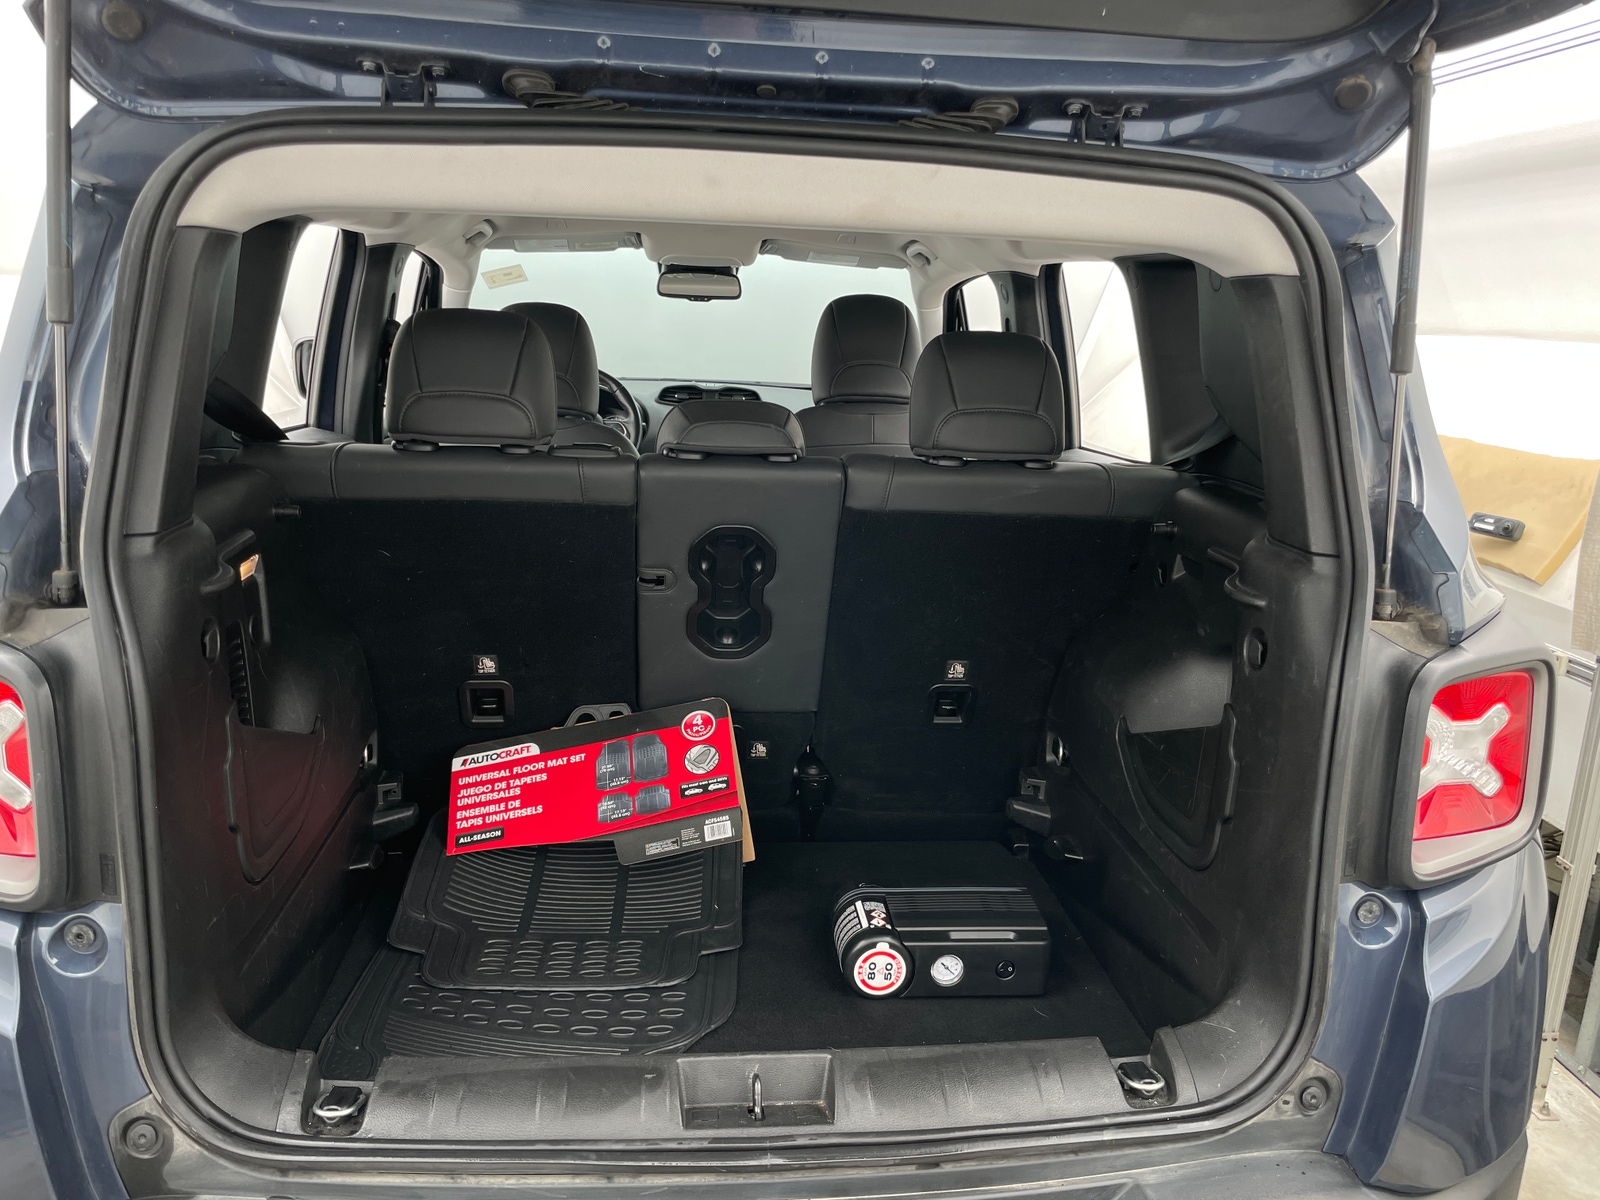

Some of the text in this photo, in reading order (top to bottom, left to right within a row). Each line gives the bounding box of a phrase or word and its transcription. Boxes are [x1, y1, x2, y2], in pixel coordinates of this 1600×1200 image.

[692, 714, 703, 725] 4
[692, 725, 705, 733] PC
[468, 745, 532, 766] AUTOCRAFT
[458, 753, 586, 786] UNIVERSAL FLOOR MAT SET
[457, 773, 548, 798] JUEGO DE TAPETES
[457, 787, 521, 807] UNIVERSALES
[456, 799, 521, 819] ENSEMBLE DE
[456, 805, 543, 829] TAPIS UNIVERSELS
[458, 830, 502, 844] ALL-SEASON
[868, 962, 876, 980] 80
[884, 962, 893, 981] 50
